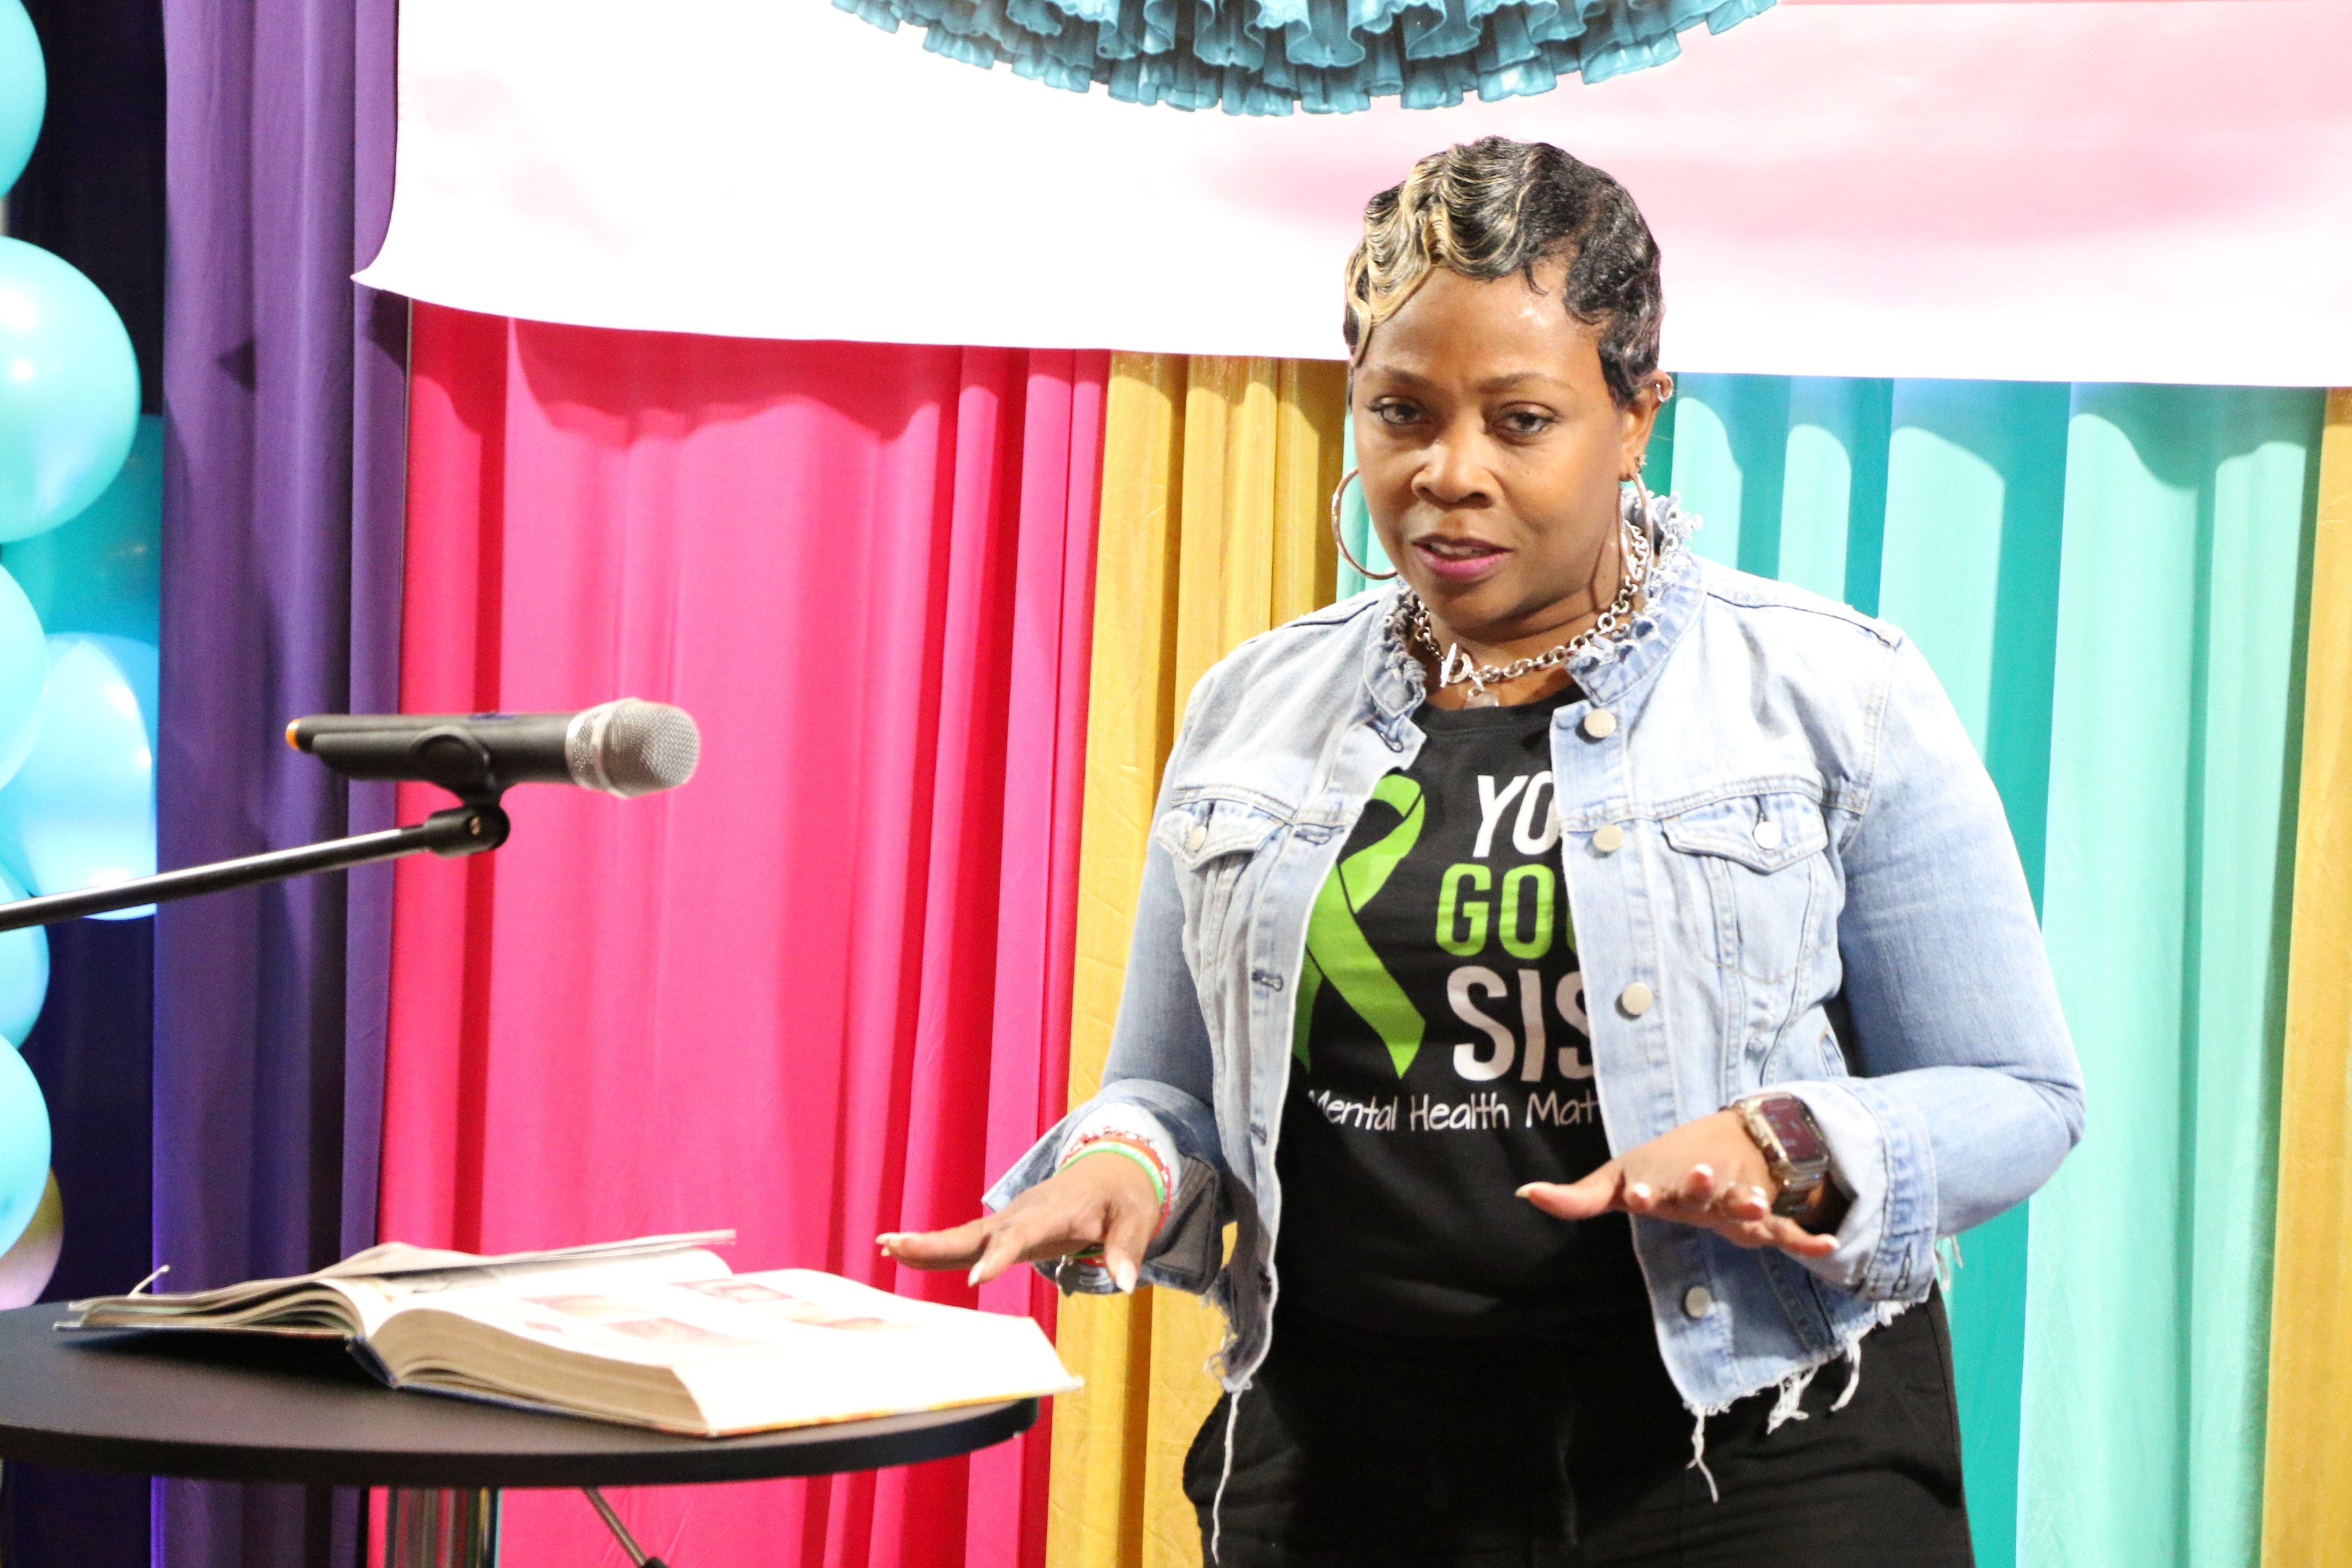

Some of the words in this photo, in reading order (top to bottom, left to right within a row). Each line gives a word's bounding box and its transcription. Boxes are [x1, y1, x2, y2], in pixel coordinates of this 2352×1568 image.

[1436, 863, 1577, 959] GO
[1410, 1093, 1510, 1130] Health
[1526, 1088, 1599, 1128] Mat
